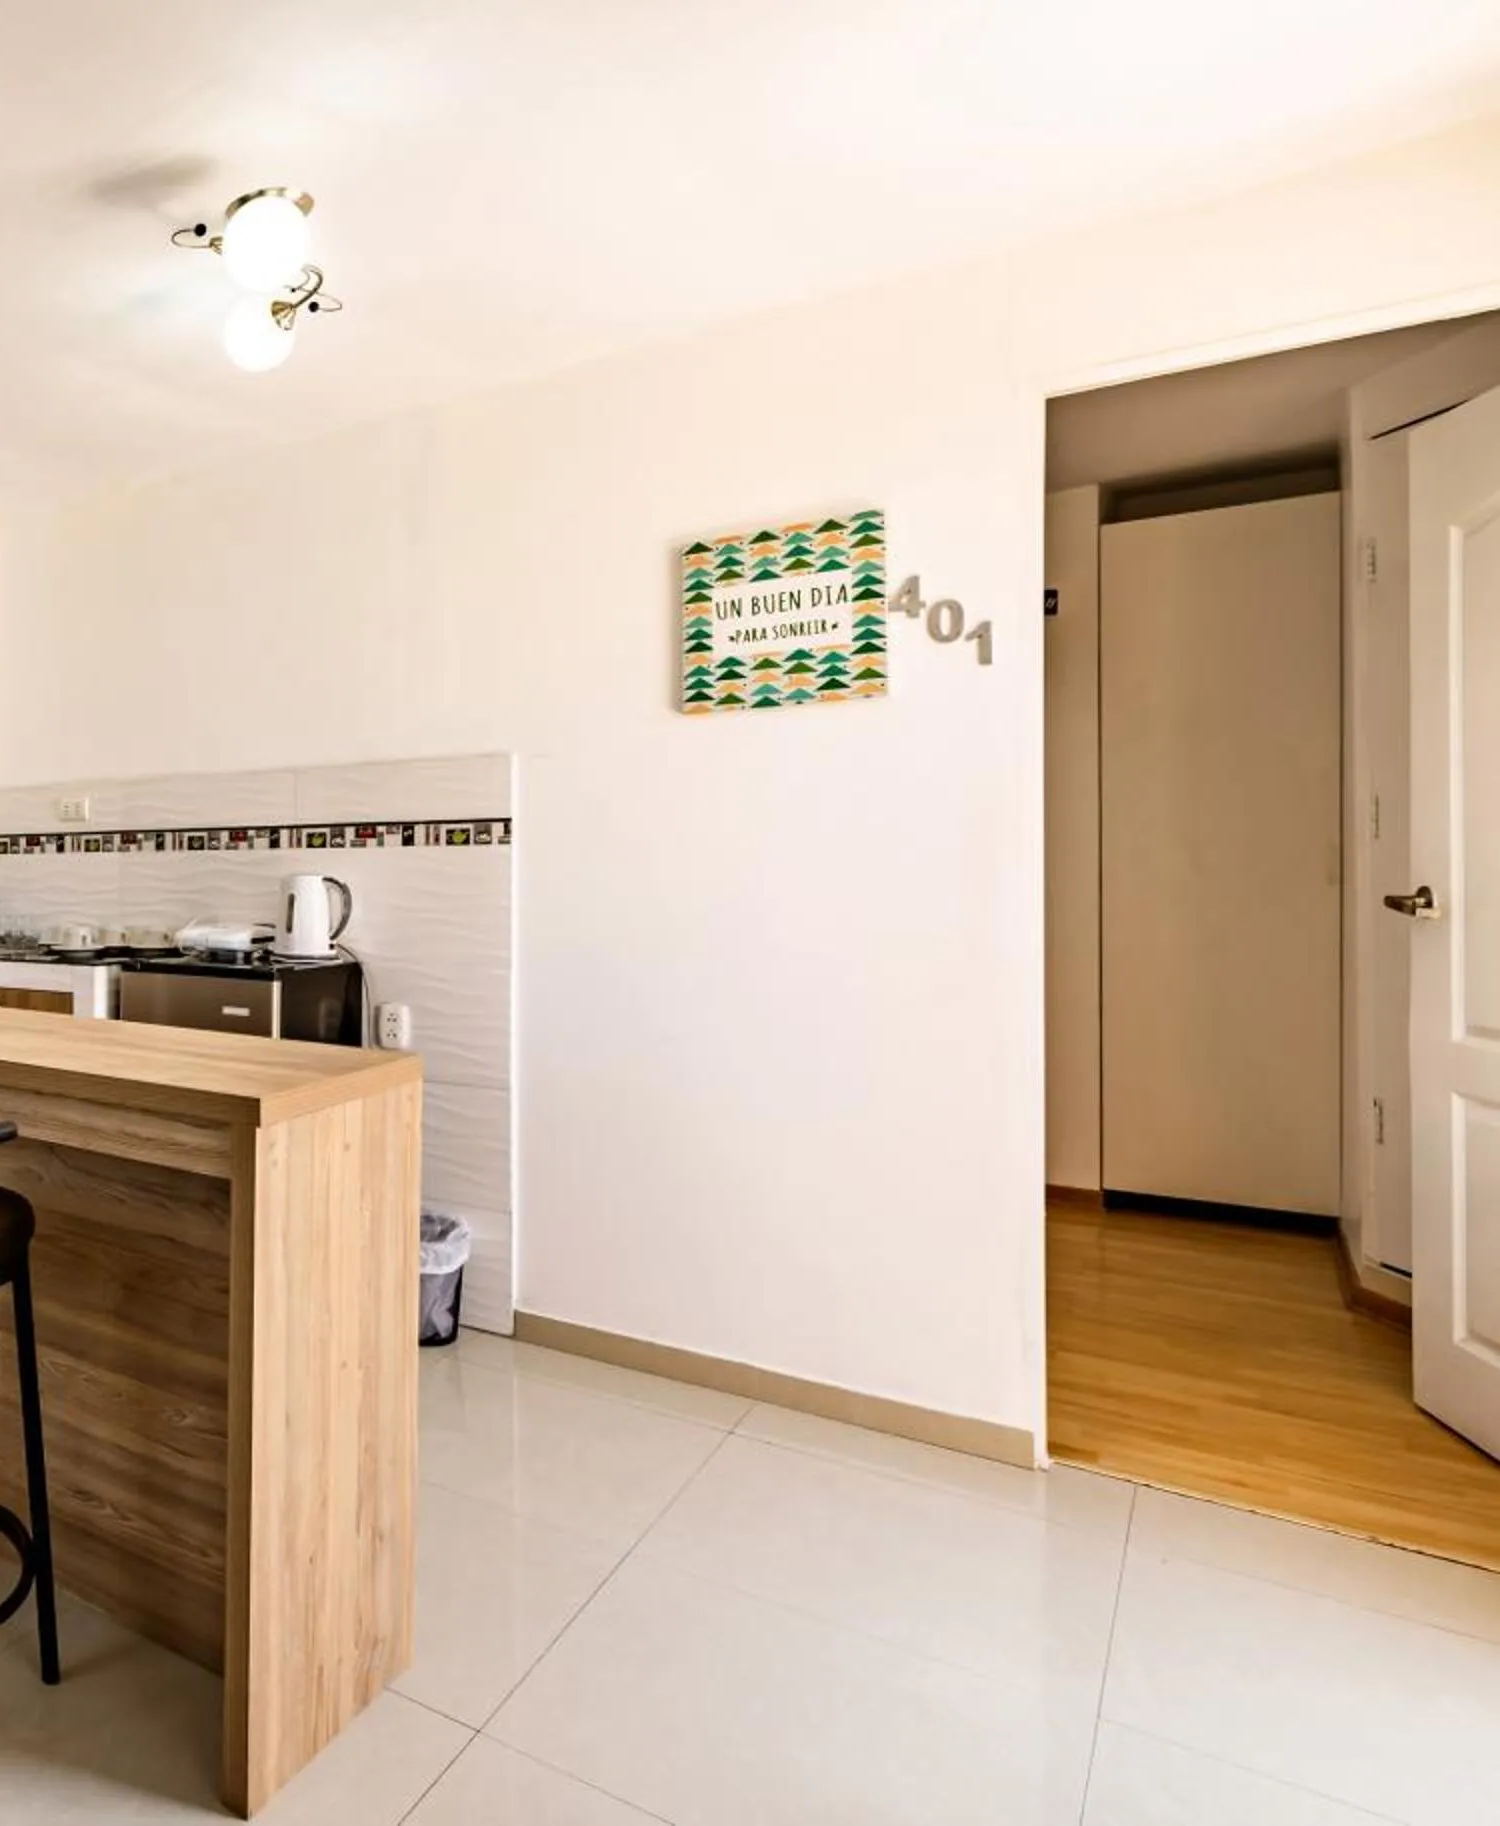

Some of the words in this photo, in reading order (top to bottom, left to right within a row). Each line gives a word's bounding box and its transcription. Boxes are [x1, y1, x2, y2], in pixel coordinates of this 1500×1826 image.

[715, 597, 743, 620] UN
[751, 589, 801, 616] BUEN
[811, 583, 848, 608] DIA
[886, 574, 993, 666] 401
[735, 627, 767, 643] PARA
[772, 619, 827, 639] SONREIR
